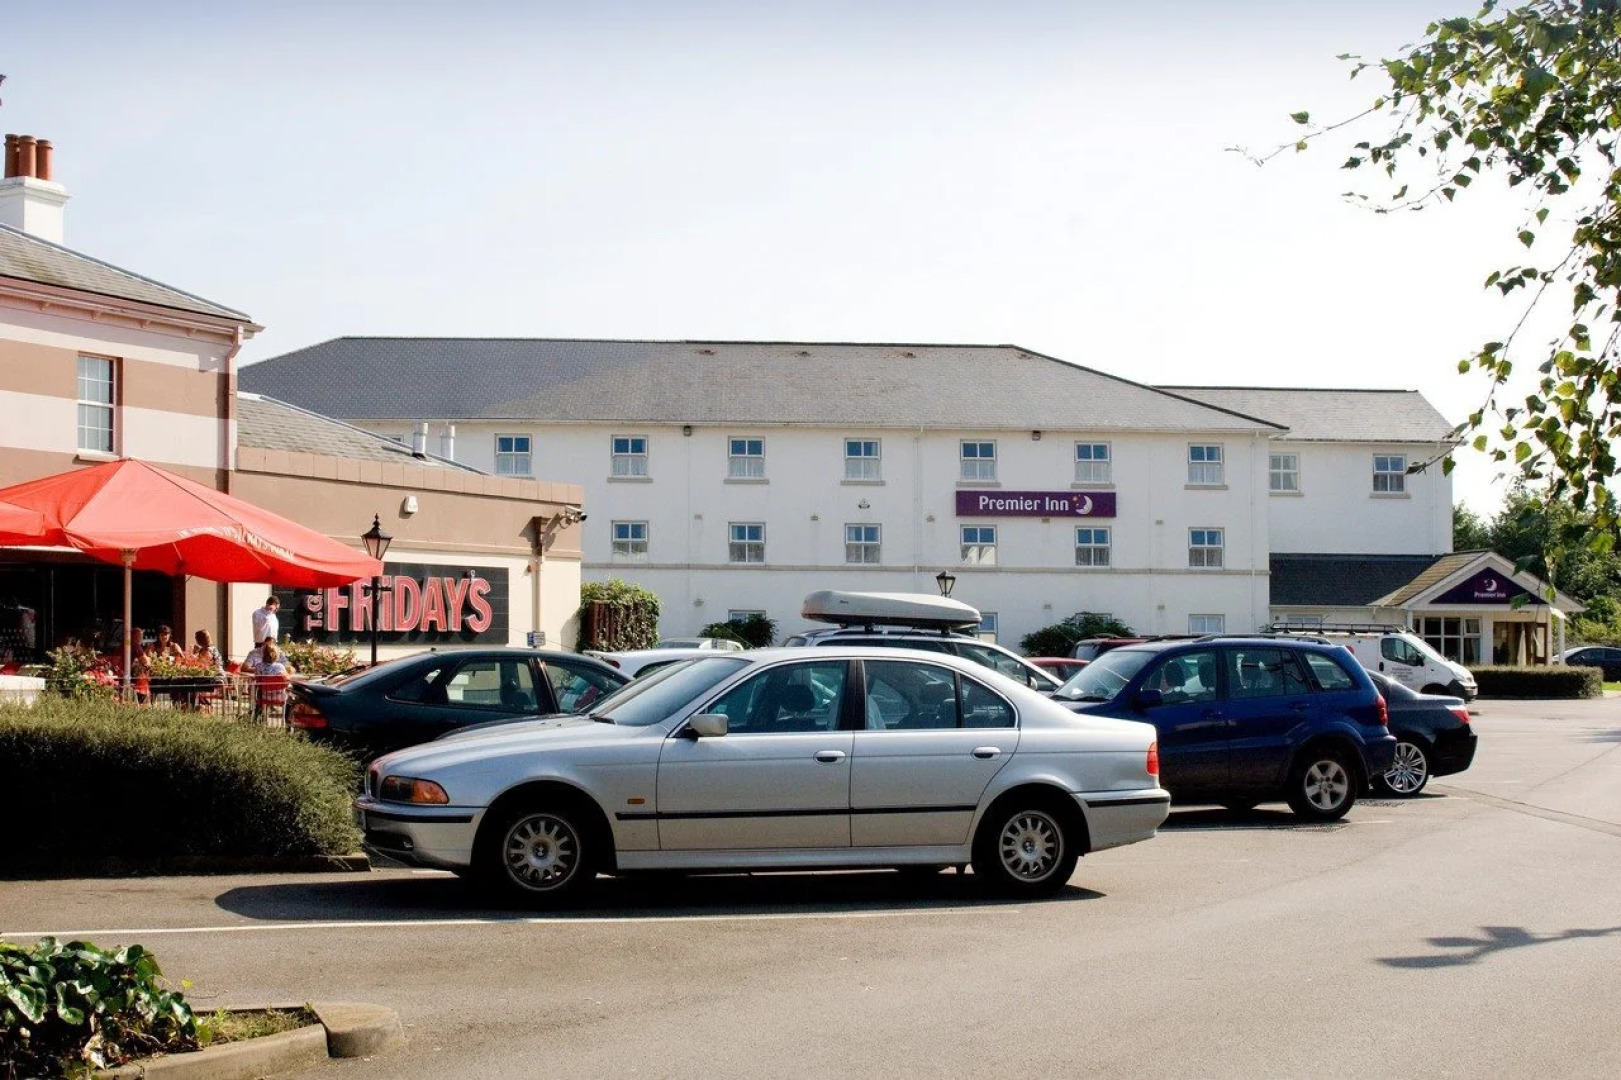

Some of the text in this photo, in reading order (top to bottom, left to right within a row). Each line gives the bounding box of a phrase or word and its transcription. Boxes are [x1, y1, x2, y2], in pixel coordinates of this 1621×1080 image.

[979, 495, 1069, 511] Premier Inn
[1473, 591, 1495, 599] Premier
[306, 588, 323, 631] T.G.
